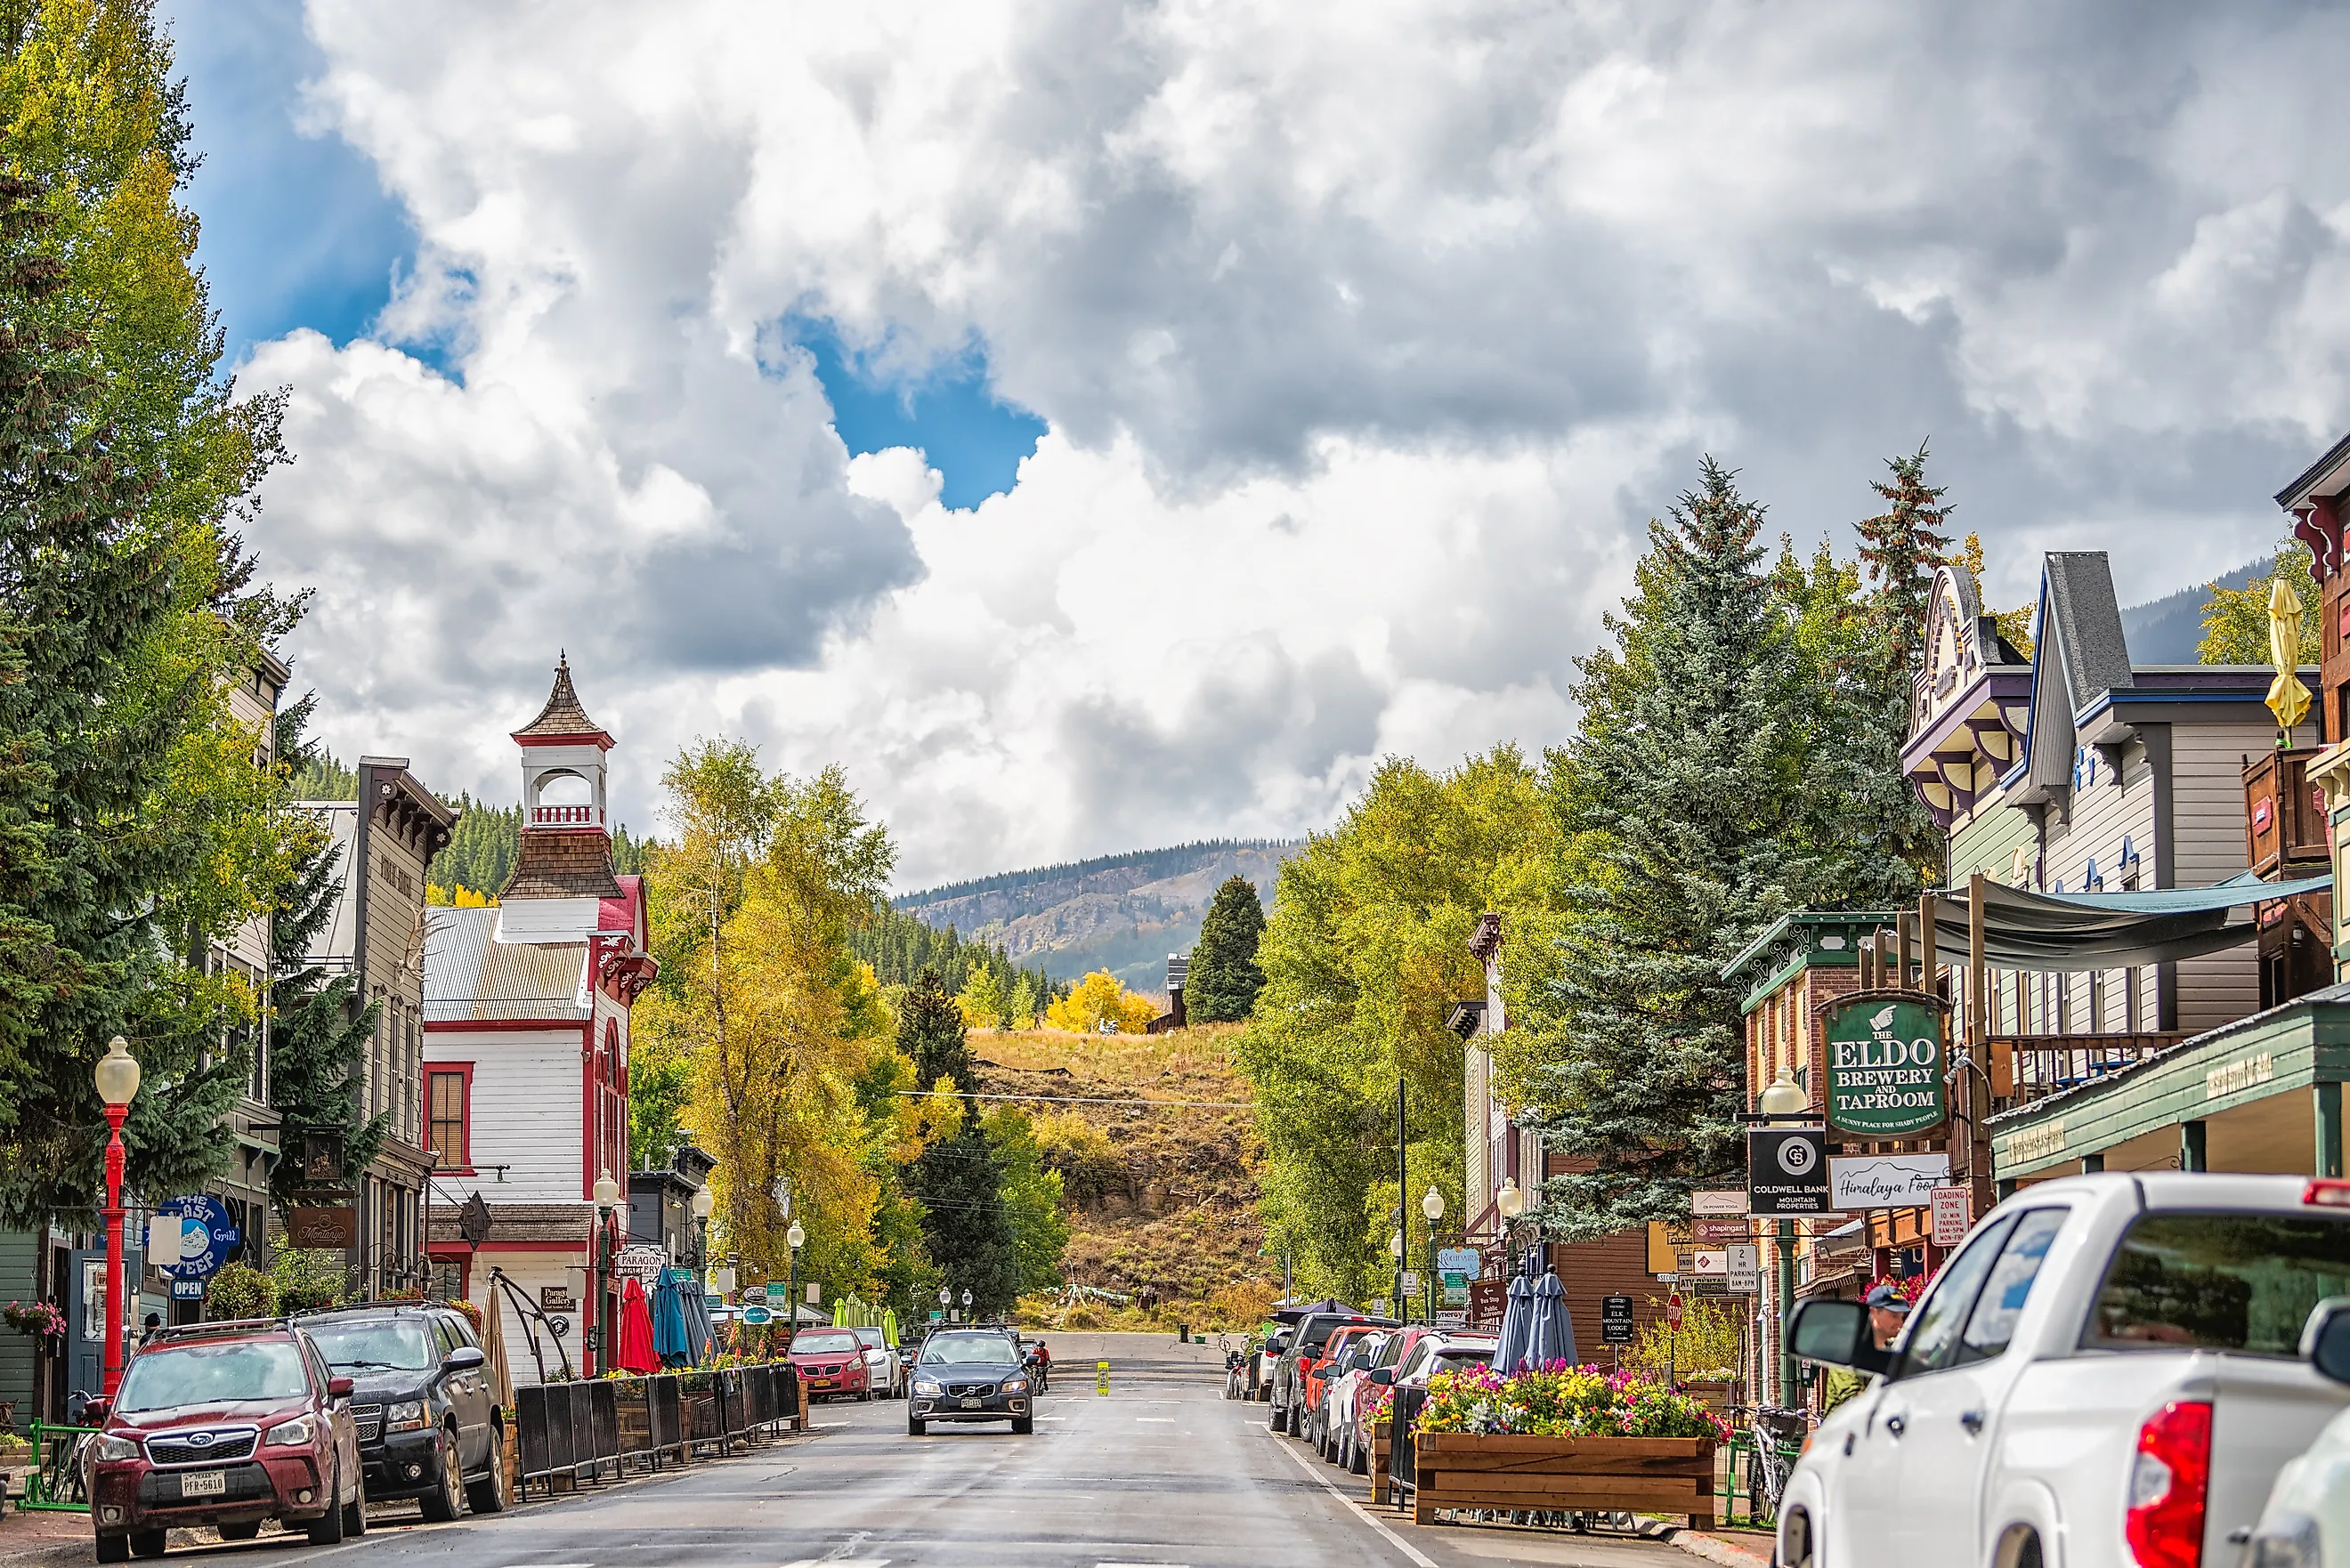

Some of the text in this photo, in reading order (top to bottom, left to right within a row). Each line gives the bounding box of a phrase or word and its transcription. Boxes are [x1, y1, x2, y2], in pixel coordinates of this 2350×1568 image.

[1872, 1031, 1893, 1040] THE
[1831, 1038, 1936, 1069] ELDO
[1835, 1069, 1934, 1087] BREWERY
[1875, 1085, 1897, 1094] AND
[1836, 1091, 1935, 1111] TAPROOM
[1841, 1117, 1862, 1128] SUNNY
[1895, 1119, 1915, 1128] SHADY
[1916, 1111, 1939, 1123] PEOPLE
[1754, 1185, 1803, 1193] COLDWELL
[1839, 1176, 1904, 1200] Himalaya
[175, 1194, 208, 1206] THE
[1933, 1192, 1965, 1200] LOADING
[1940, 1201, 1960, 1209] ZONE
[1709, 1224, 1746, 1233] shapingart
[214, 1228, 237, 1242] Grill
[1738, 1249, 1745, 1258] 2
[165, 1250, 214, 1275] TEEP
[621, 1256, 661, 1265] PARAGON
[174, 1281, 202, 1295] OPEN
[545, 1296, 571, 1306] Gallery
[1479, 1297, 1489, 1305] Bus
[1479, 1310, 1503, 1318] Restrooms
[1669, 1305, 1681, 1321] STOP
